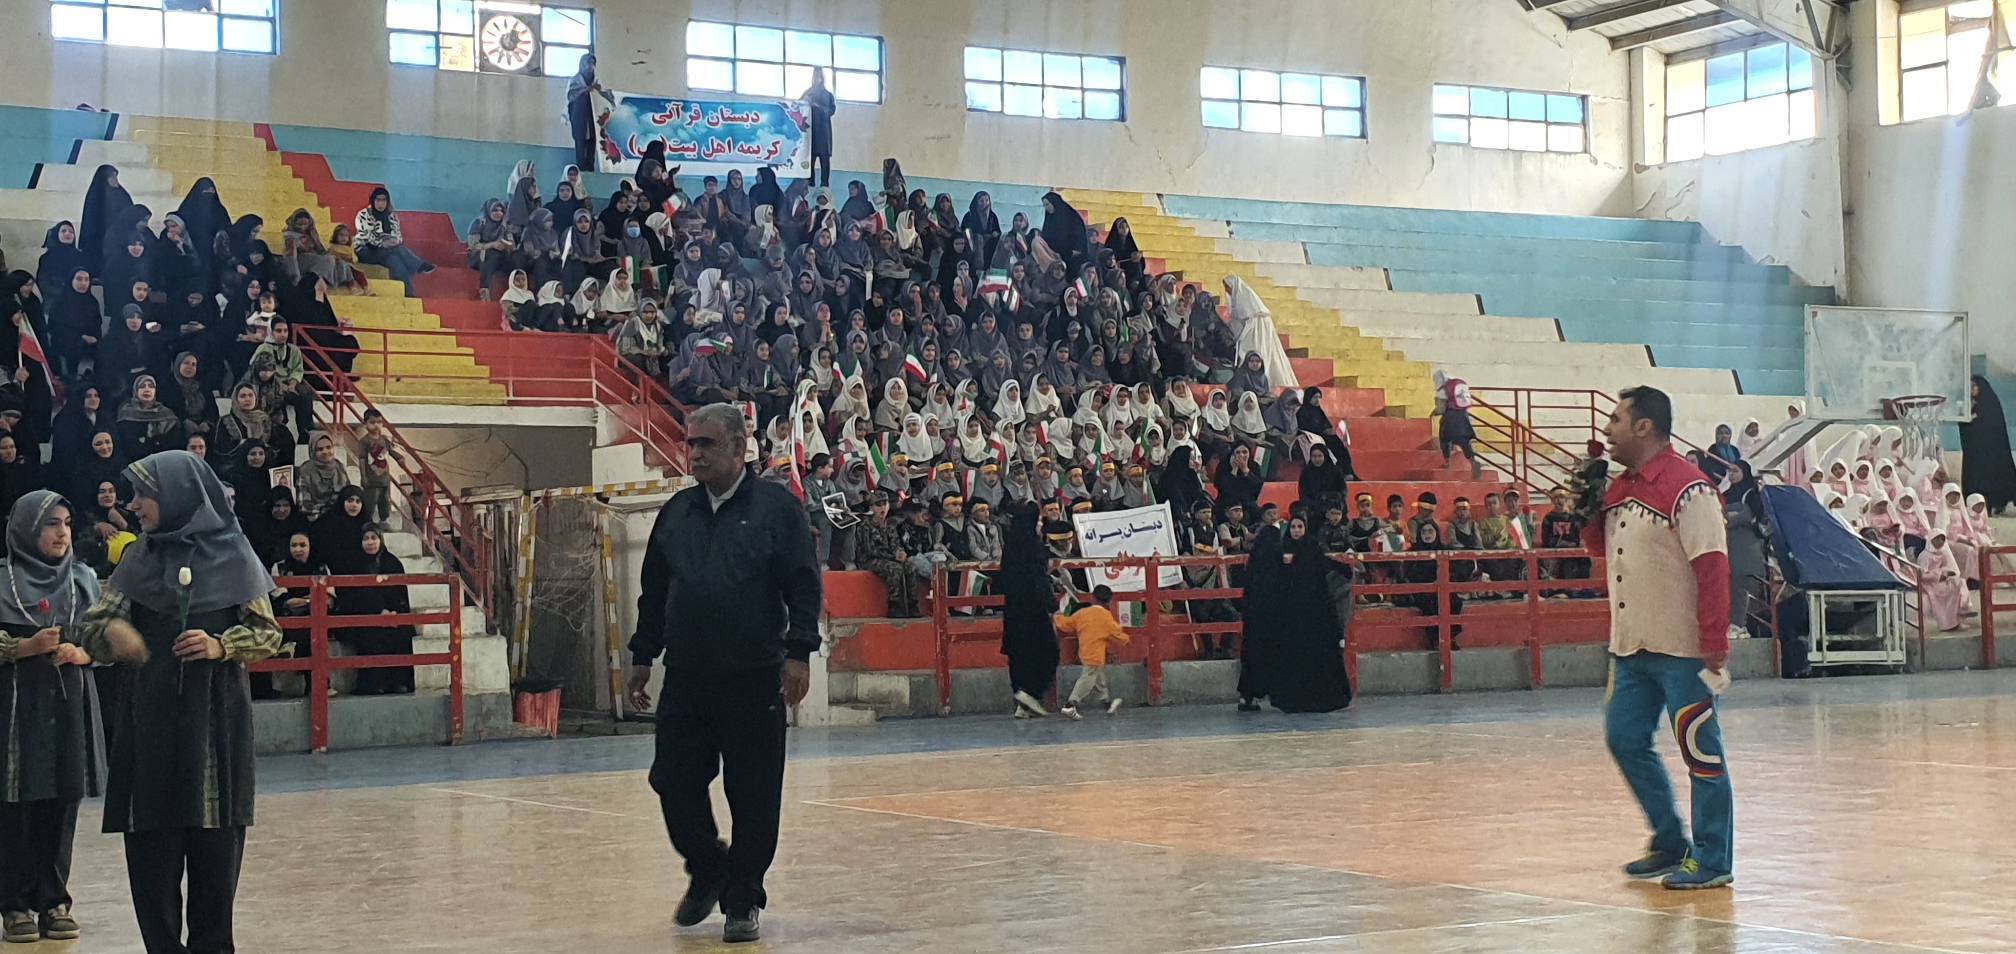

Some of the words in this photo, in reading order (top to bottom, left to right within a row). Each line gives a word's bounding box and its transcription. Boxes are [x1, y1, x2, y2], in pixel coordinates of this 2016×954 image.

[706, 105, 761, 128] دبستان
[702, 137, 732, 159] اهل
[738, 139, 782, 160] کریمه
[1123, 519, 1163, 538] دبستان
